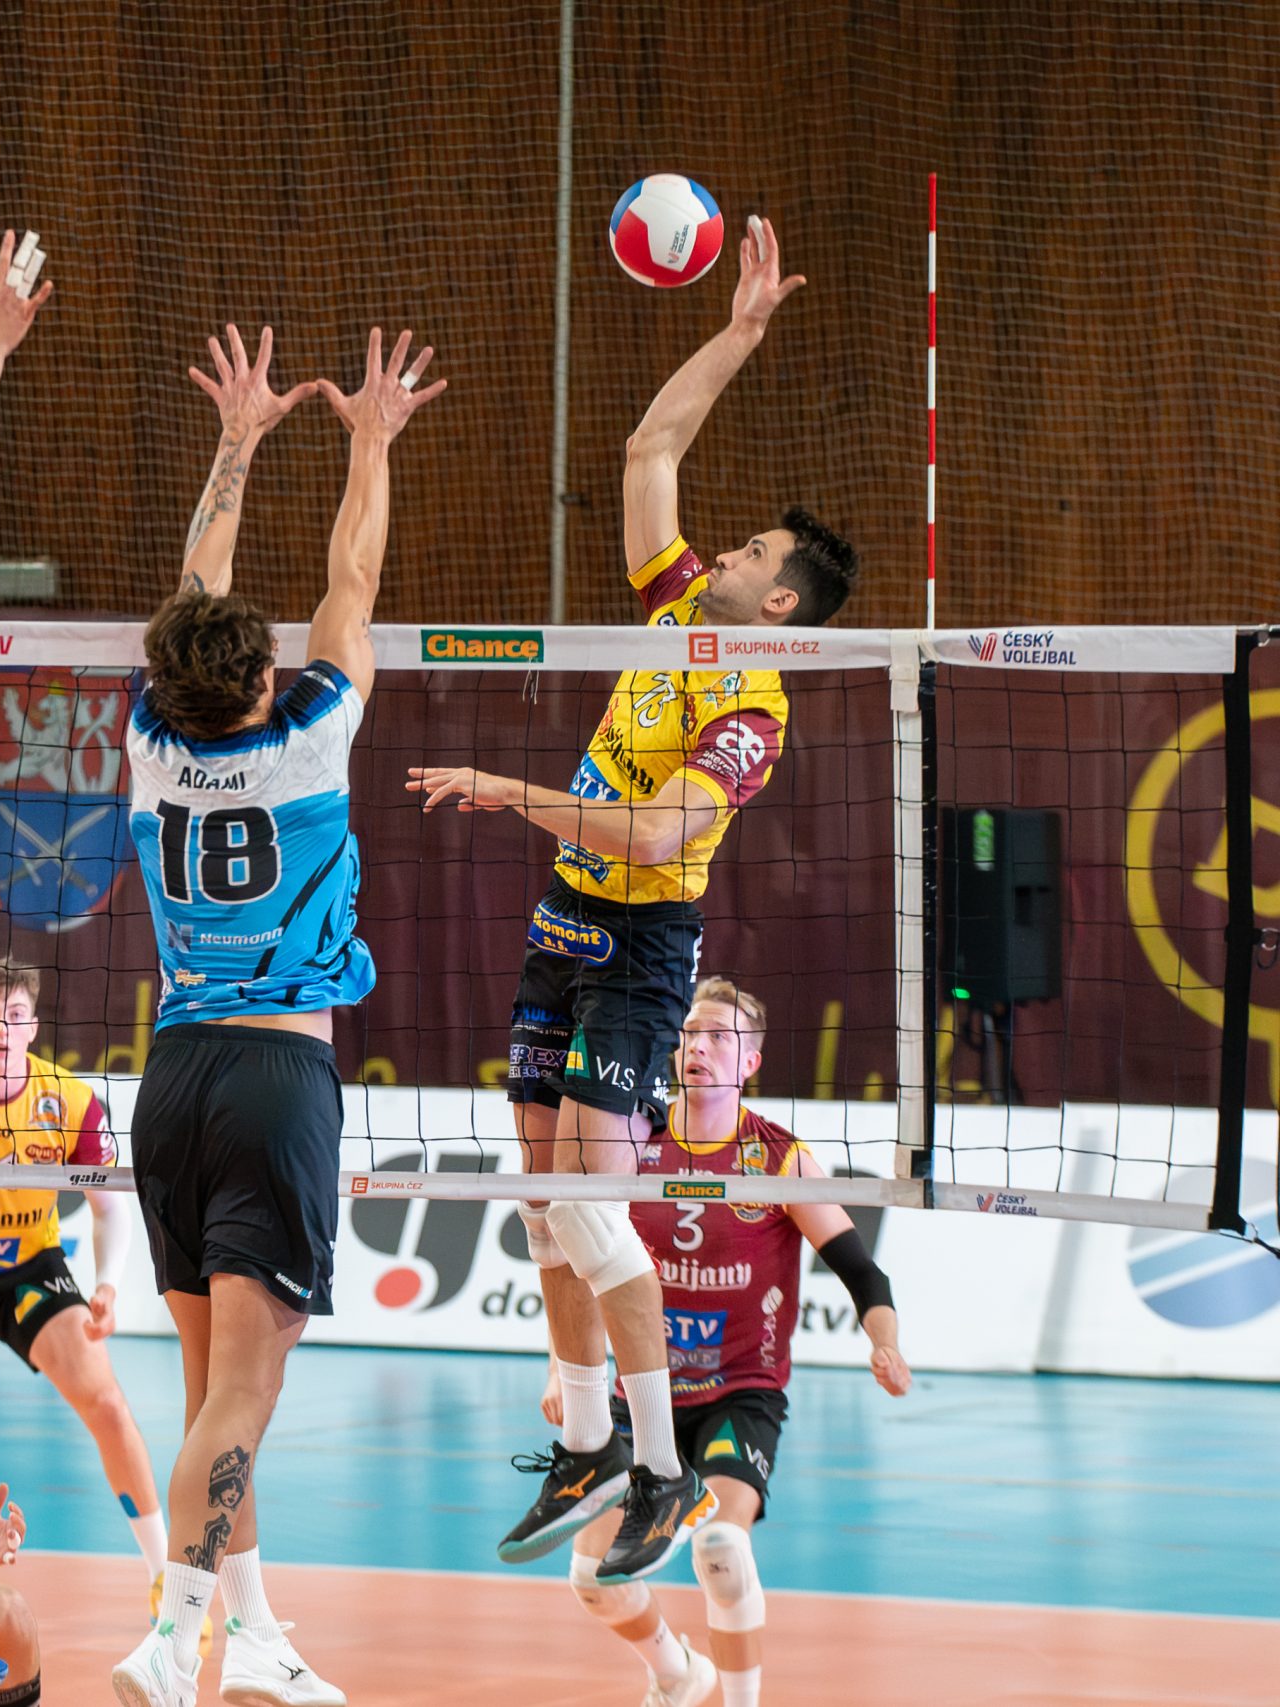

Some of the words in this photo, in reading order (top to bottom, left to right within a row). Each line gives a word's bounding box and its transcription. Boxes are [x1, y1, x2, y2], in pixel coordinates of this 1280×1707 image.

[426, 634, 539, 659] Chance
[724, 641, 787, 655] SKUPINA
[791, 638, 820, 655] ČEZ
[1002, 631, 1054, 648] ČESKÝ
[1002, 650, 1077, 665] VOLEJBAL
[177, 766, 247, 790] ADAMI
[156, 797, 283, 905] 18
[200, 926, 284, 946] Neumann
[595, 1056, 636, 1092] VLS
[69, 1171, 110, 1187] gala
[370, 1181, 405, 1190] SKUPINA
[407, 1180, 424, 1190] ČEZ
[665, 1183, 725, 1198] Chance
[672, 1202, 706, 1252] 3
